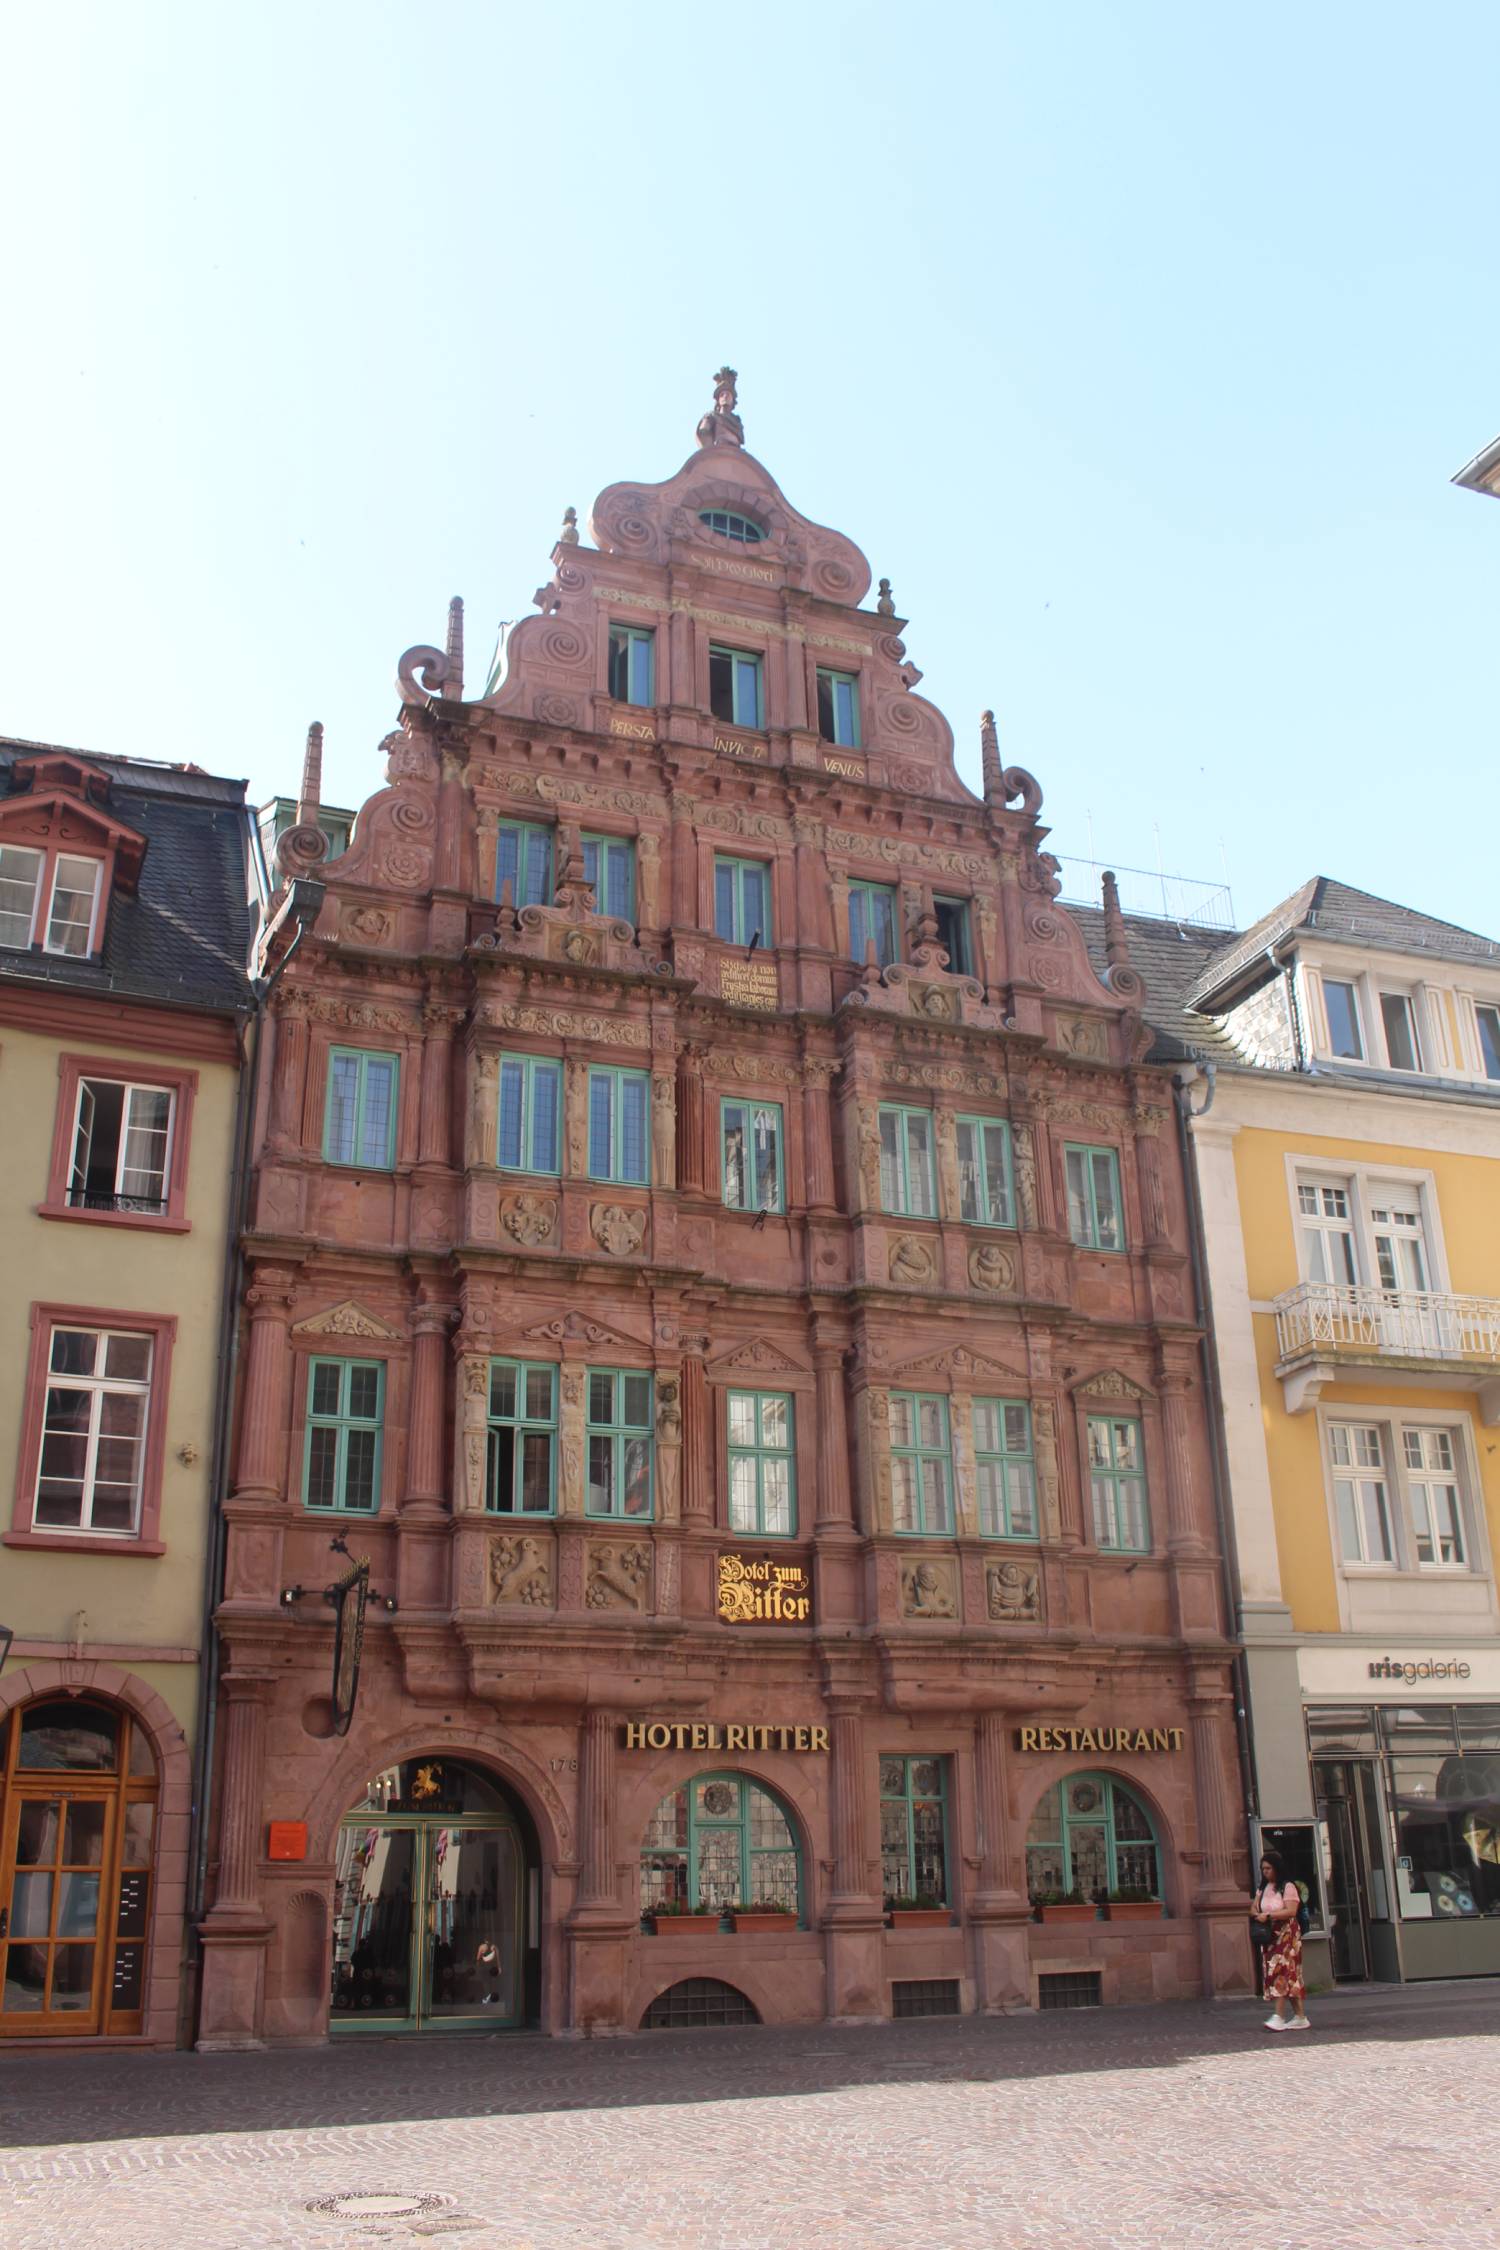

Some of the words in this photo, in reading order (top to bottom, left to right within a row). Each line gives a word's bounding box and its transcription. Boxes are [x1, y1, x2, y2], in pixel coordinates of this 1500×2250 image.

[610, 717, 657, 741] PERSTA
[823, 757, 865, 779] VENUS
[719, 1554, 774, 1582] Hotel
[770, 1566, 806, 1592] zum
[718, 1581, 810, 1622] Ritter
[1367, 1656, 1471, 1686] irisgalerie
[627, 1723, 722, 1750] HOTEL
[727, 1724, 831, 1751] RITTER
[1020, 1727, 1185, 1752] RESTAURANT
[551, 1758, 577, 1773] 178
